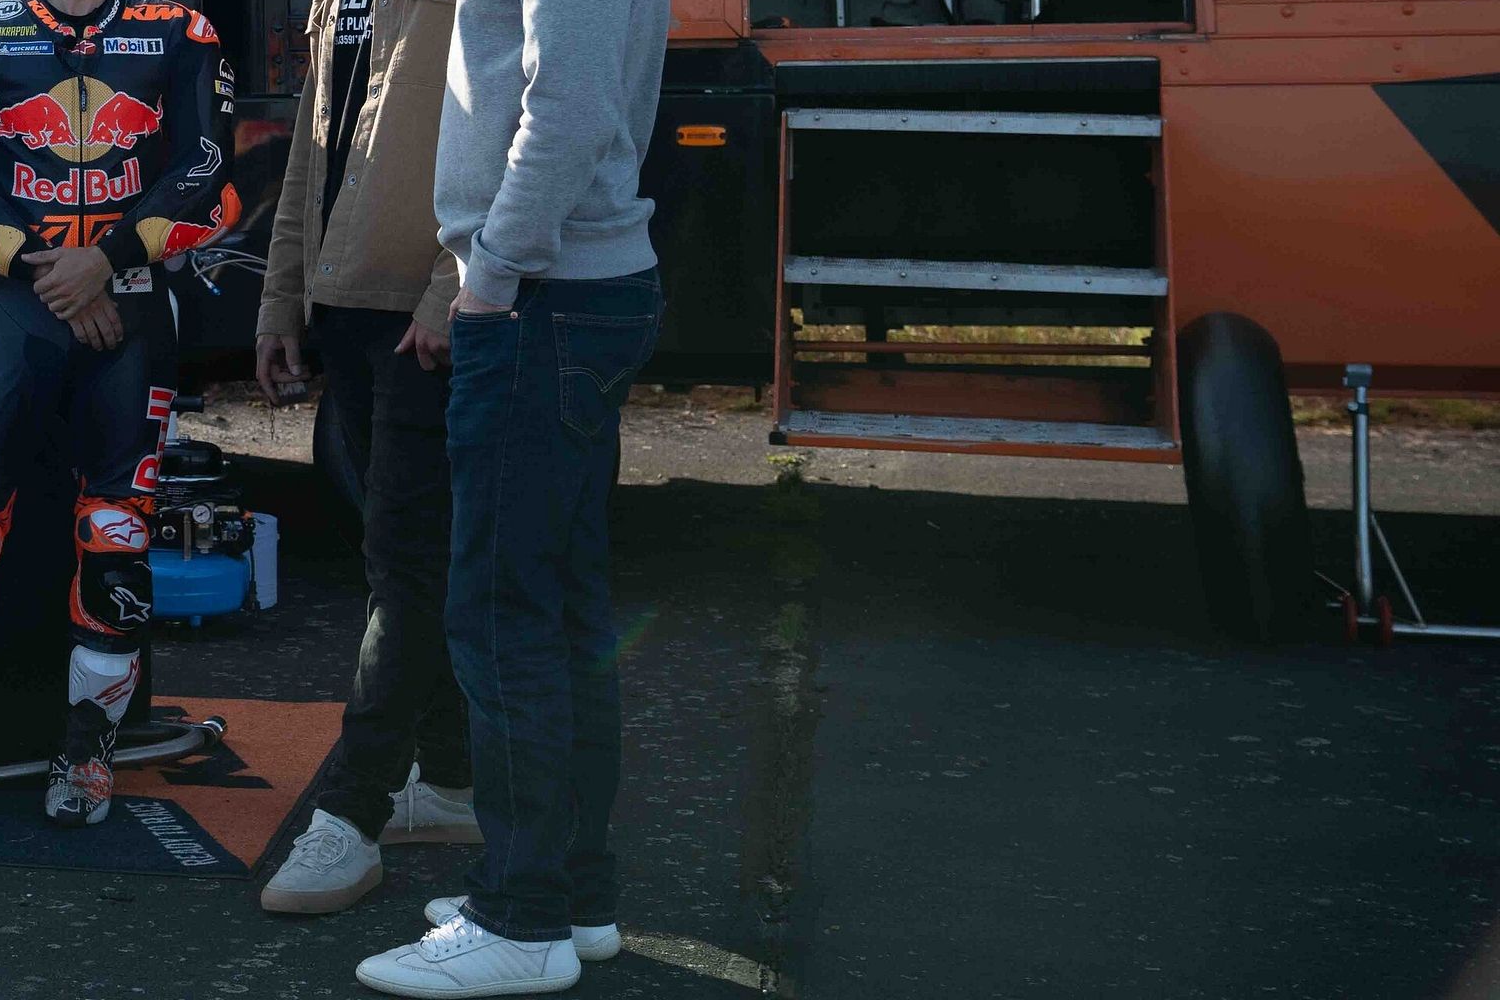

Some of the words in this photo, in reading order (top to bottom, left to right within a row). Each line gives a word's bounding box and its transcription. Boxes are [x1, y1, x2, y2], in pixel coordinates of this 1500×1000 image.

[26, 0, 60, 31] KTM
[121, 3, 184, 21] KTM
[105, 40, 144, 52] Mobil
[11, 161, 81, 206] Red
[84, 156, 142, 206] Bull
[158, 837, 220, 867] READY
